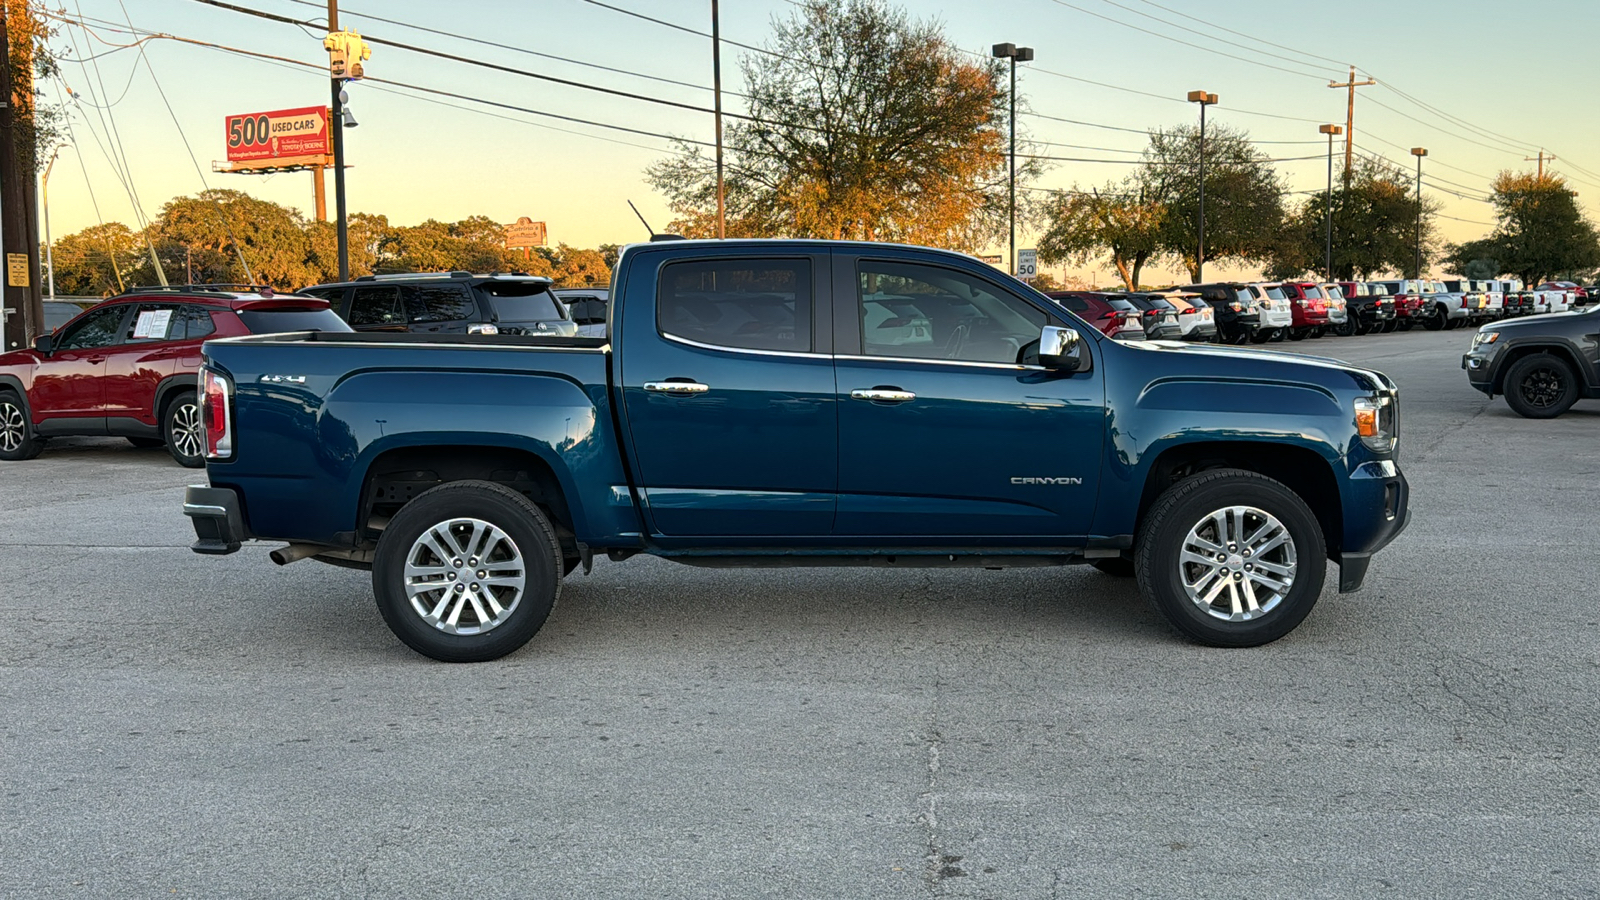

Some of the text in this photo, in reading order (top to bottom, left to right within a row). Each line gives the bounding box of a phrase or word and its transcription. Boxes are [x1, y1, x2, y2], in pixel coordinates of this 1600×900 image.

[228, 114, 269, 148] 500
[272, 119, 315, 132] USED CARS
[1019, 265, 1034, 274] 50
[1010, 477, 1082, 485] CANYON
